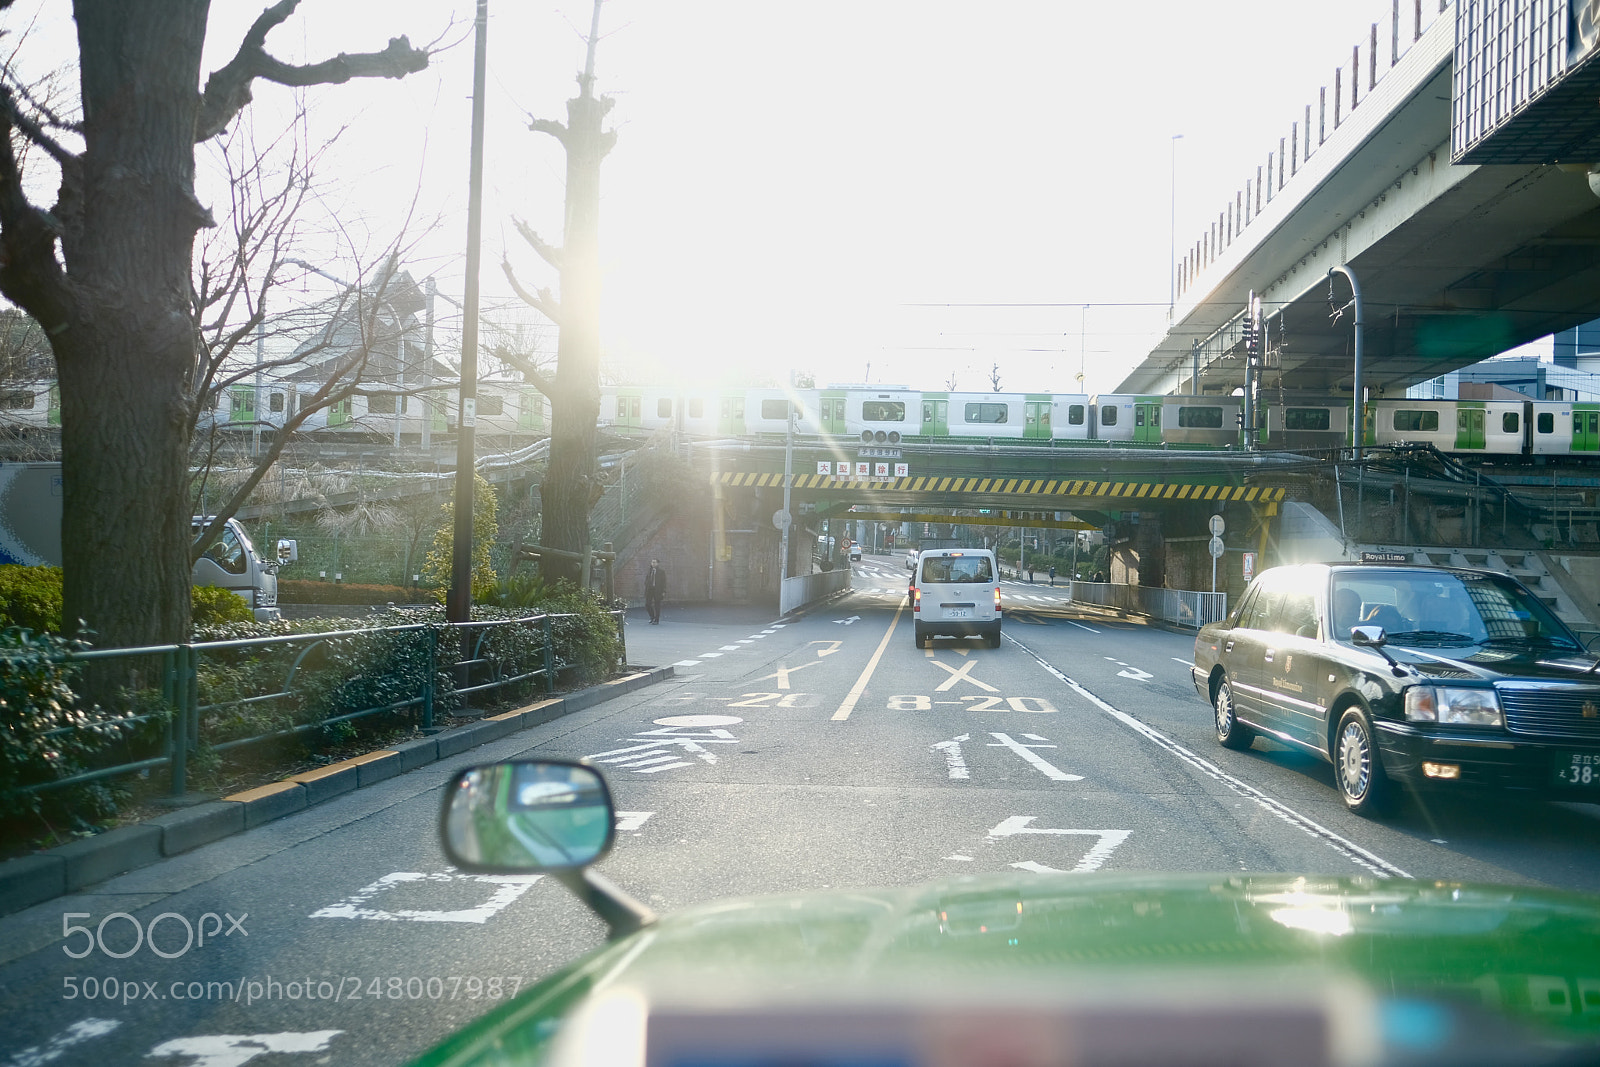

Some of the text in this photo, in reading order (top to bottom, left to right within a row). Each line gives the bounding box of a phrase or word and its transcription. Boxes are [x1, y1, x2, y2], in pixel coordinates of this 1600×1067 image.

[820, 463, 906, 474] 大型最徐行
[1365, 553, 1406, 561] Royal Limo
[886, 694, 1060, 713] 8-20
[1571, 754, 1592, 765] 足立
